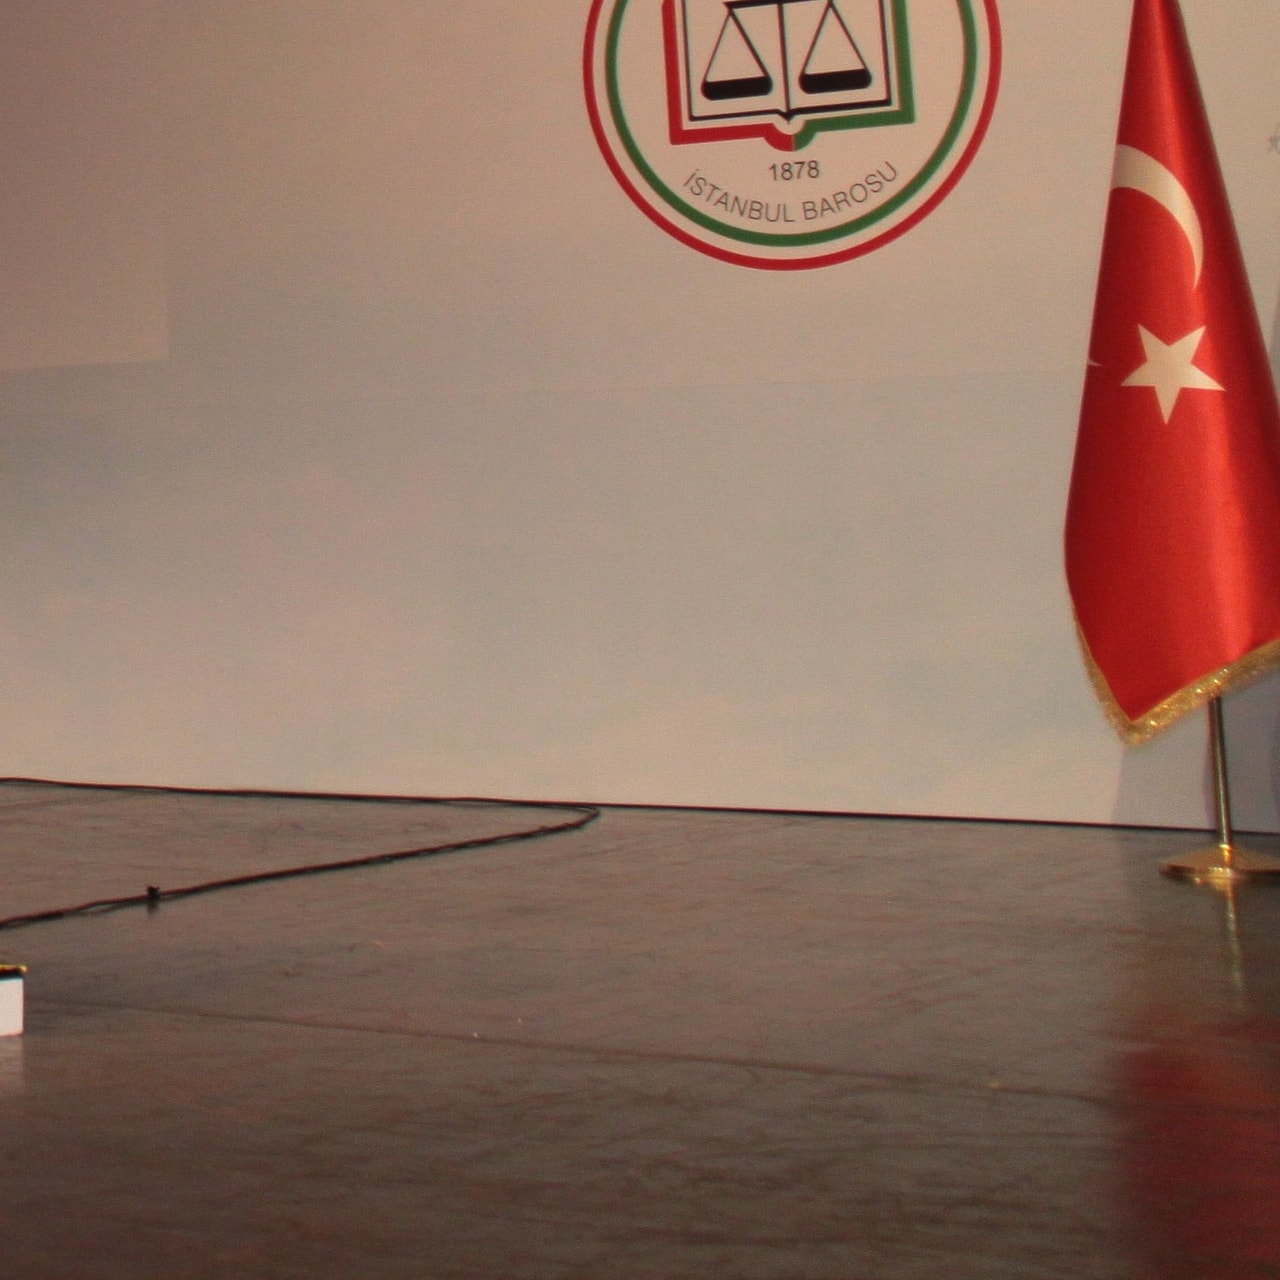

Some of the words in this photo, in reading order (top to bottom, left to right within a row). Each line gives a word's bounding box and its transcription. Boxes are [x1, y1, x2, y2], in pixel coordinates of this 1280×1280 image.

[683, 168, 795, 222] İSTANBUL
[802, 160, 898, 221] BAROSU
[768, 159, 820, 181] 1878
